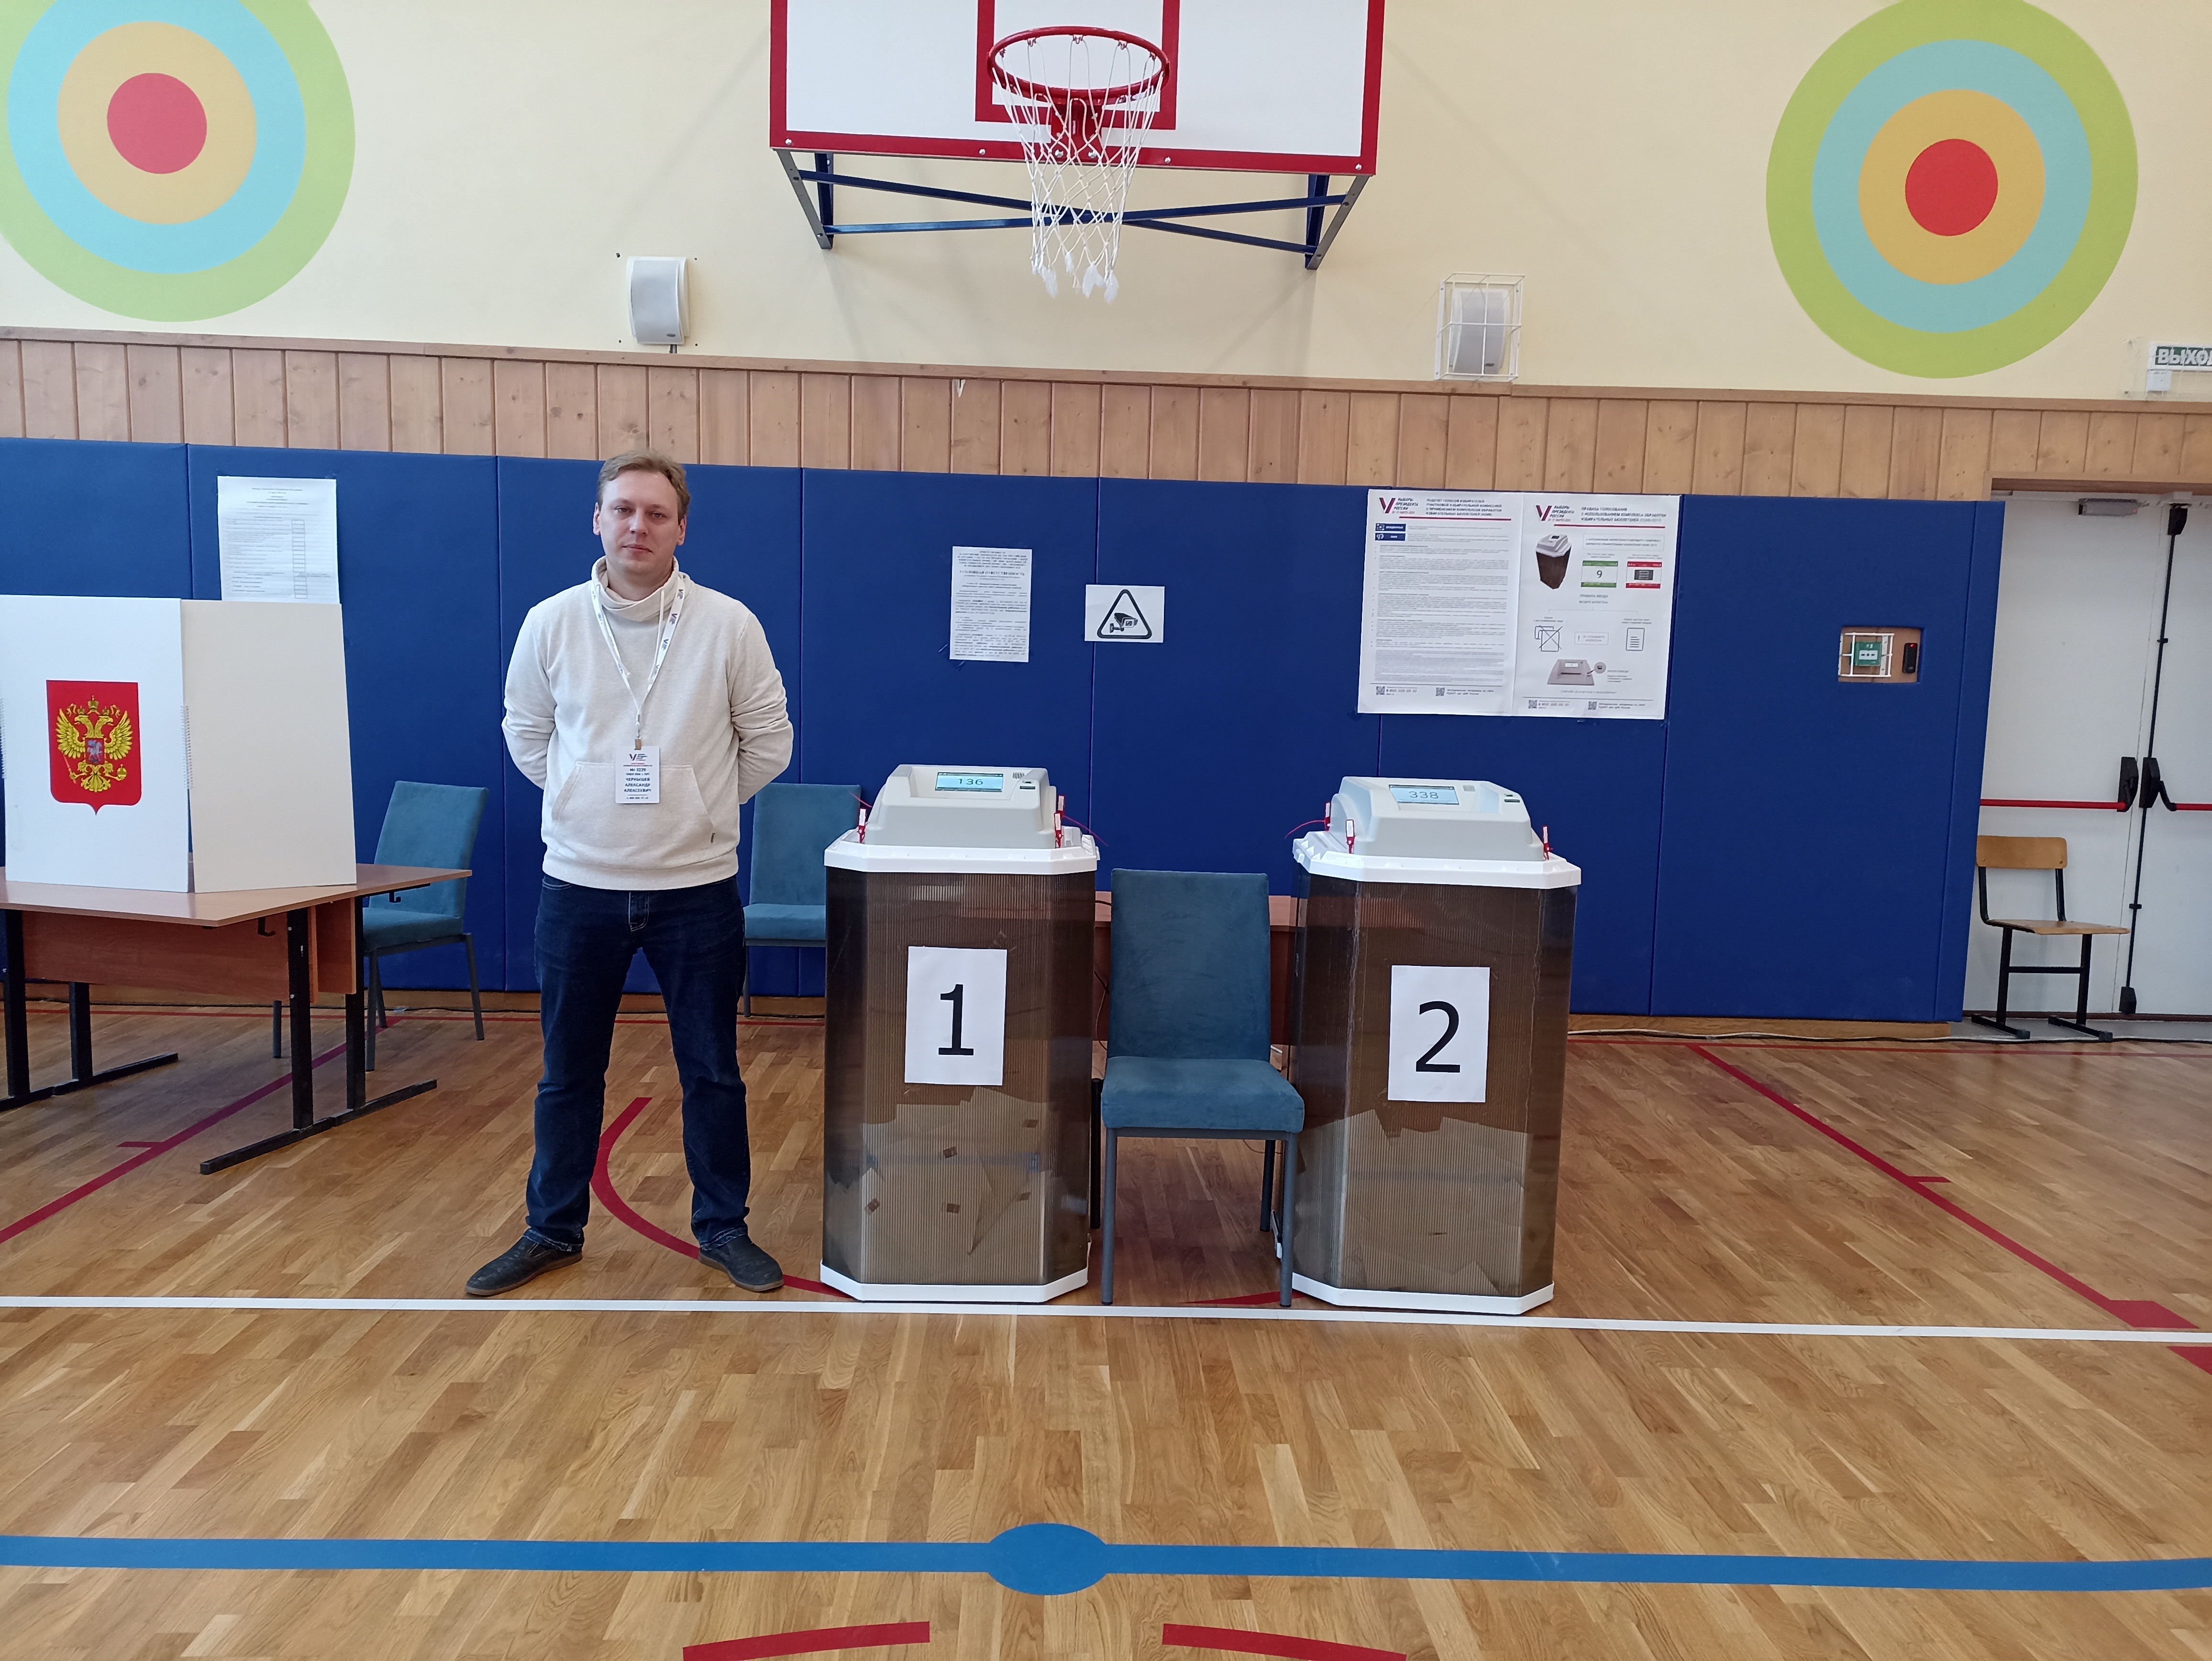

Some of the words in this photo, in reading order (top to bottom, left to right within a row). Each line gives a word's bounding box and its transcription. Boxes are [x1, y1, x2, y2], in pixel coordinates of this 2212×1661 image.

[1596, 570, 1603, 578] 9
[1409, 791, 1439, 799] 338
[939, 984, 974, 1056] 1
[1416, 1000, 1460, 1073] 2
